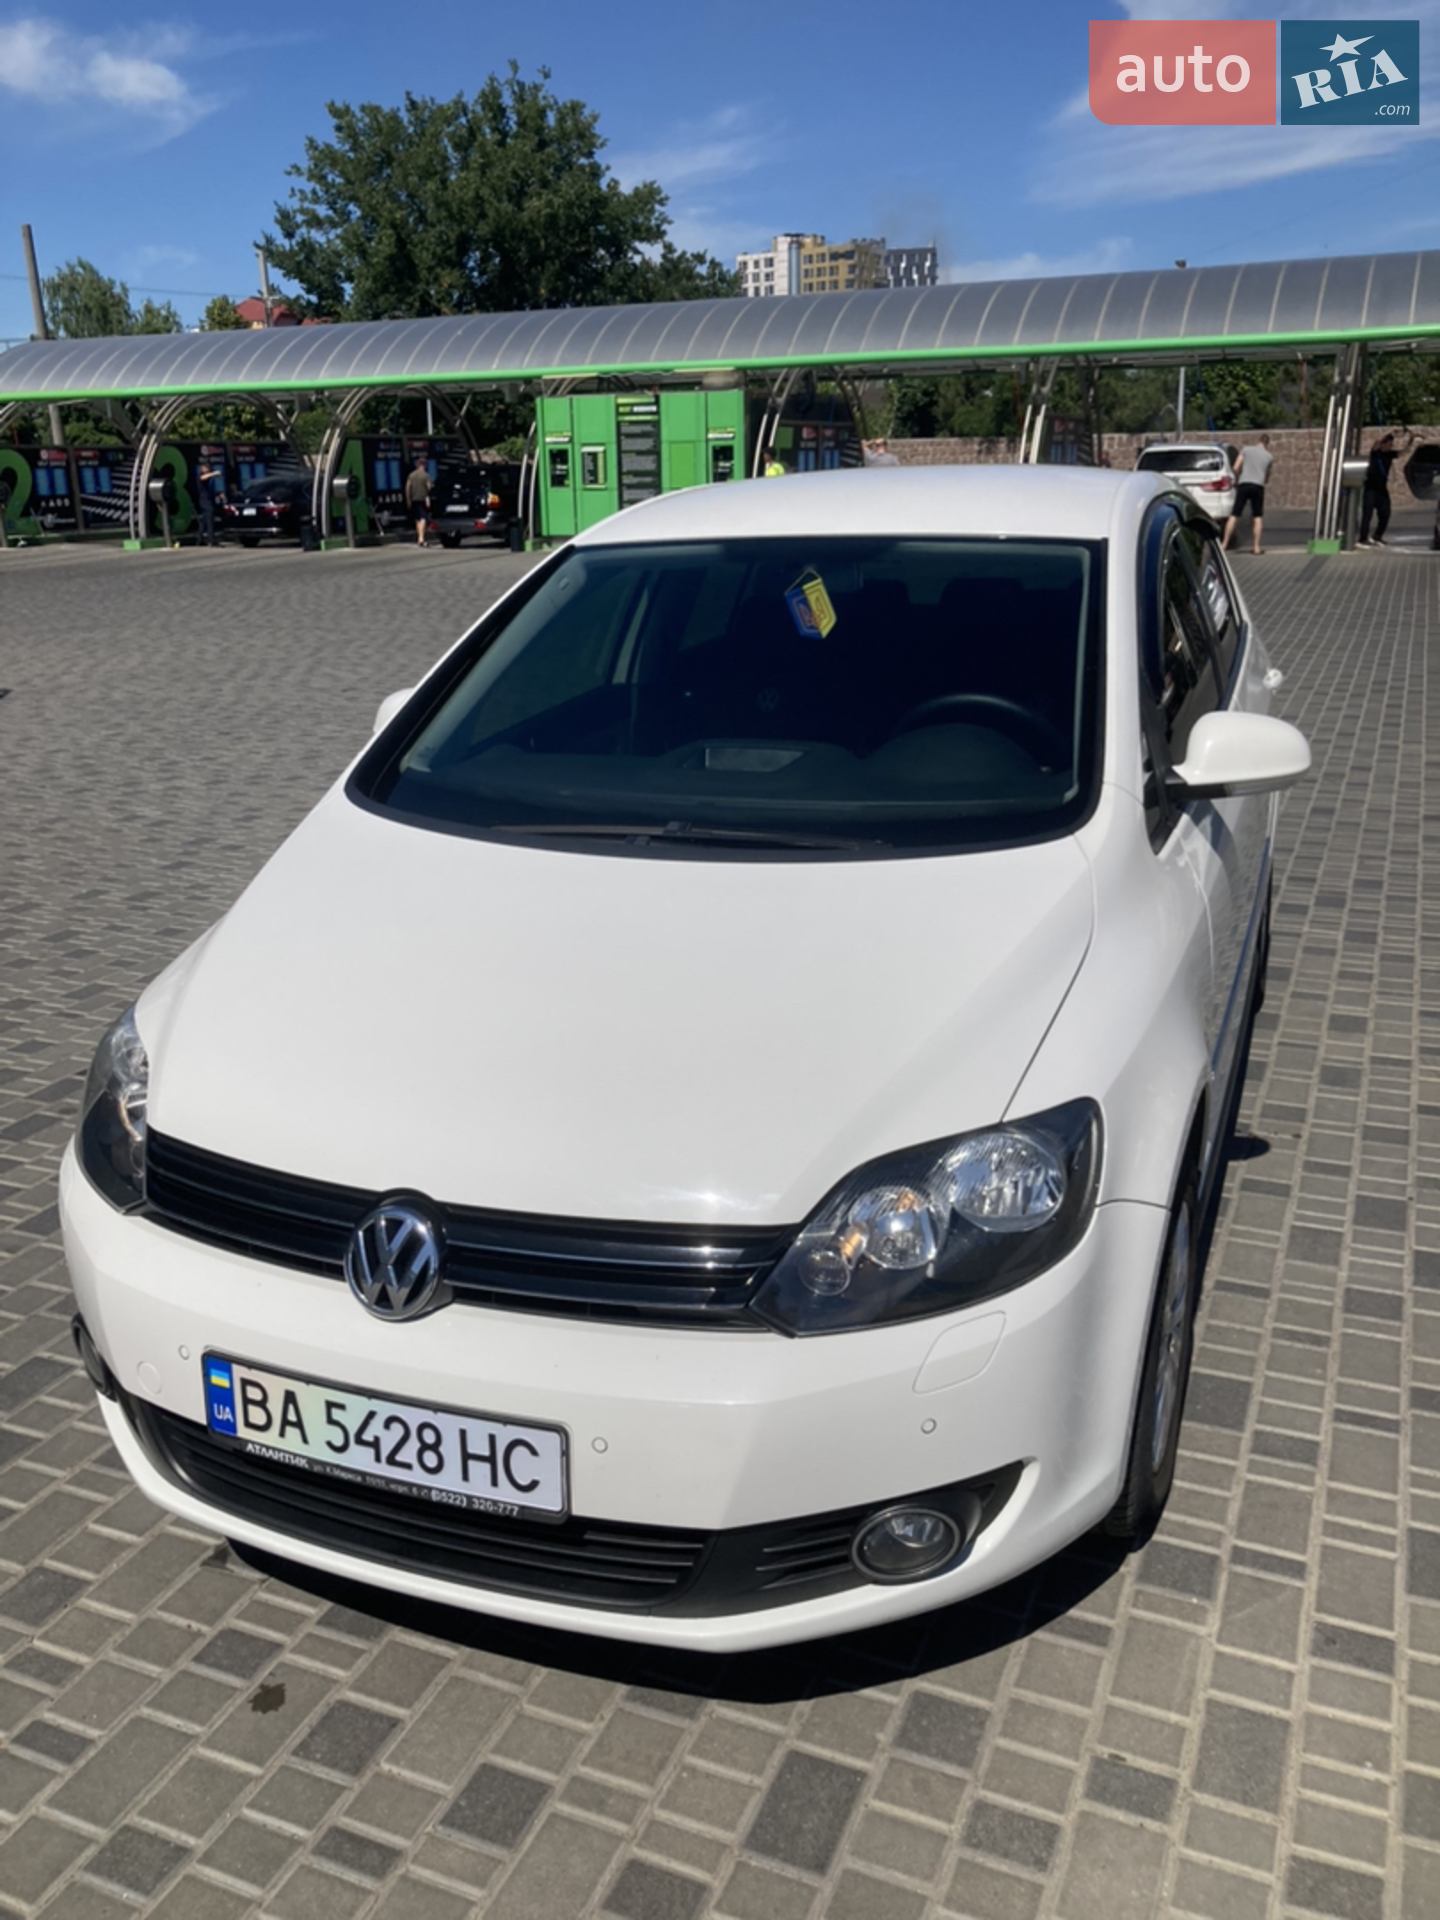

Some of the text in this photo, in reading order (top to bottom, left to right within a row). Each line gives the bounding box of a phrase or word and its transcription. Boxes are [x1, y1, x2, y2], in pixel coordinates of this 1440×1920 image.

[0, 448, 43, 536] 2
[154, 446, 192, 534] 3
[332, 439, 370, 533] 4
[213, 1403, 234, 1423] UA
[239, 1377, 542, 1494] BA 5428 HC
[246, 1442, 309, 1469] АТЛАНТИК
[472, 1498, 520, 1517] 320-777
